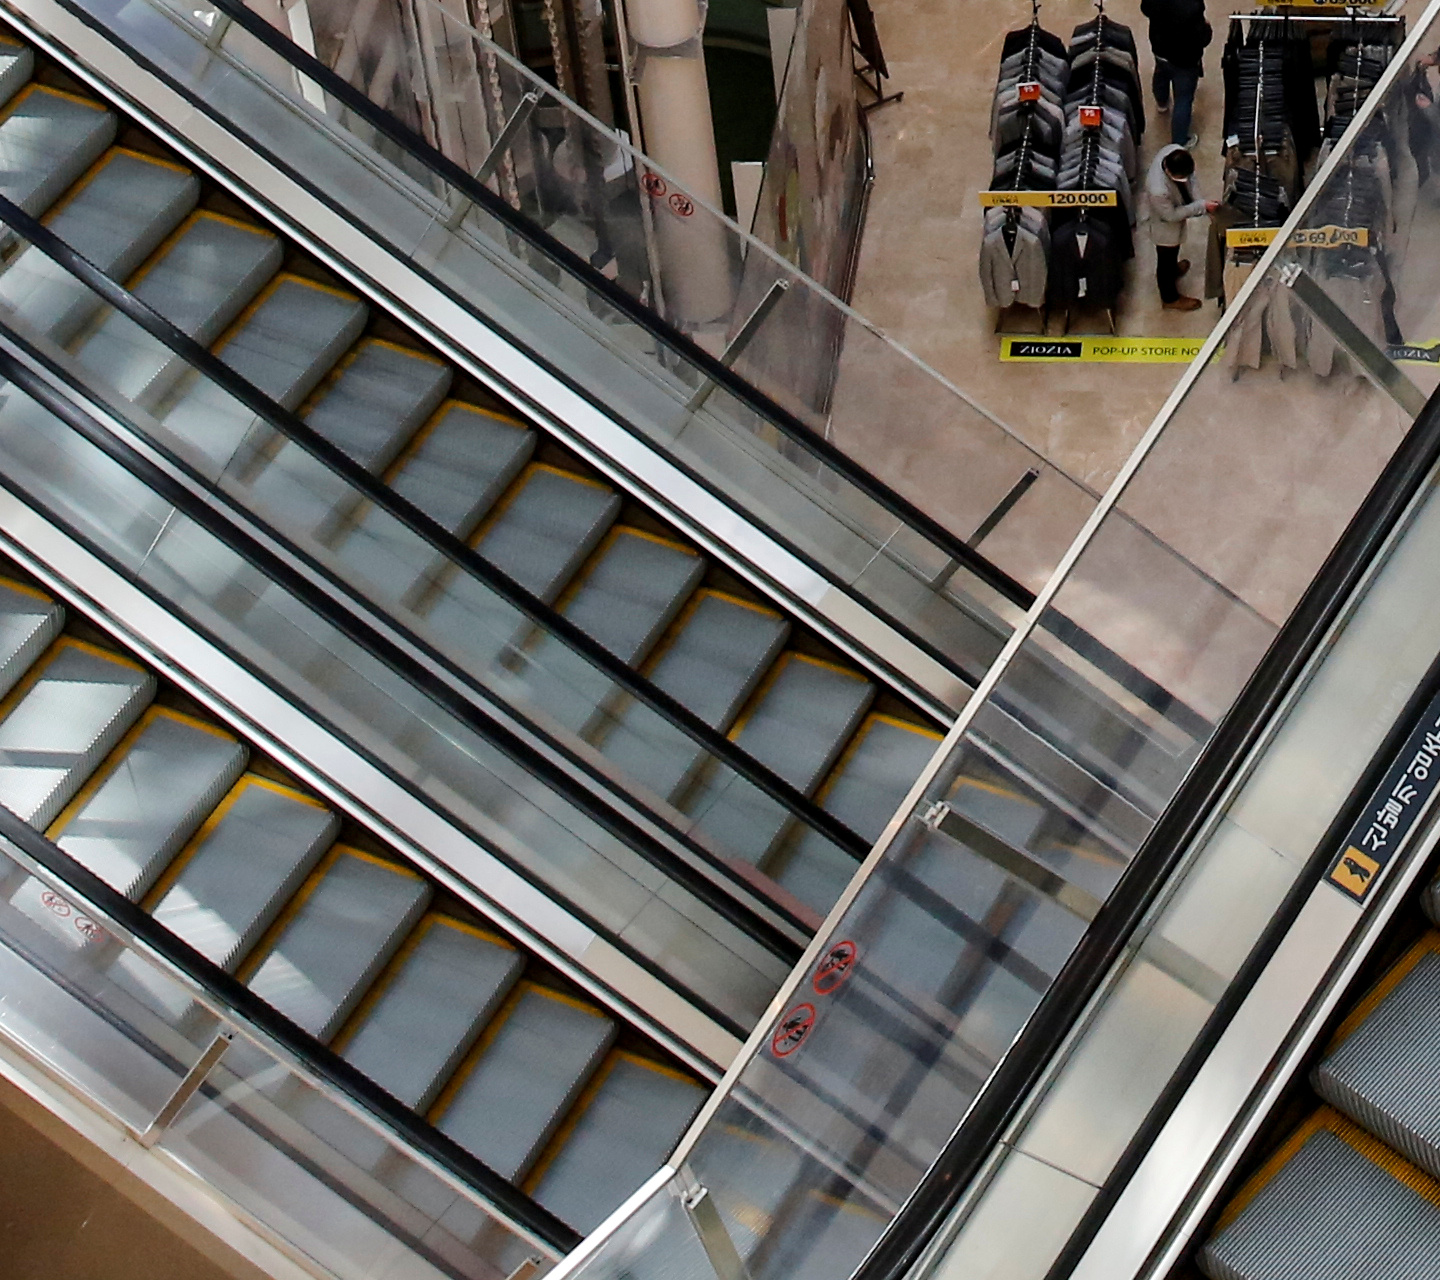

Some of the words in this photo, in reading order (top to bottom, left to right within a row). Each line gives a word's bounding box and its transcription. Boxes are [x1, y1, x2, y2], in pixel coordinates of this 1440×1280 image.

[1048, 193, 1108, 204] 120,000
[1019, 345, 1072, 355] ZIOZIA
[1093, 347, 1138, 356] POP-UP
[1142, 347, 1178, 356] STORE
